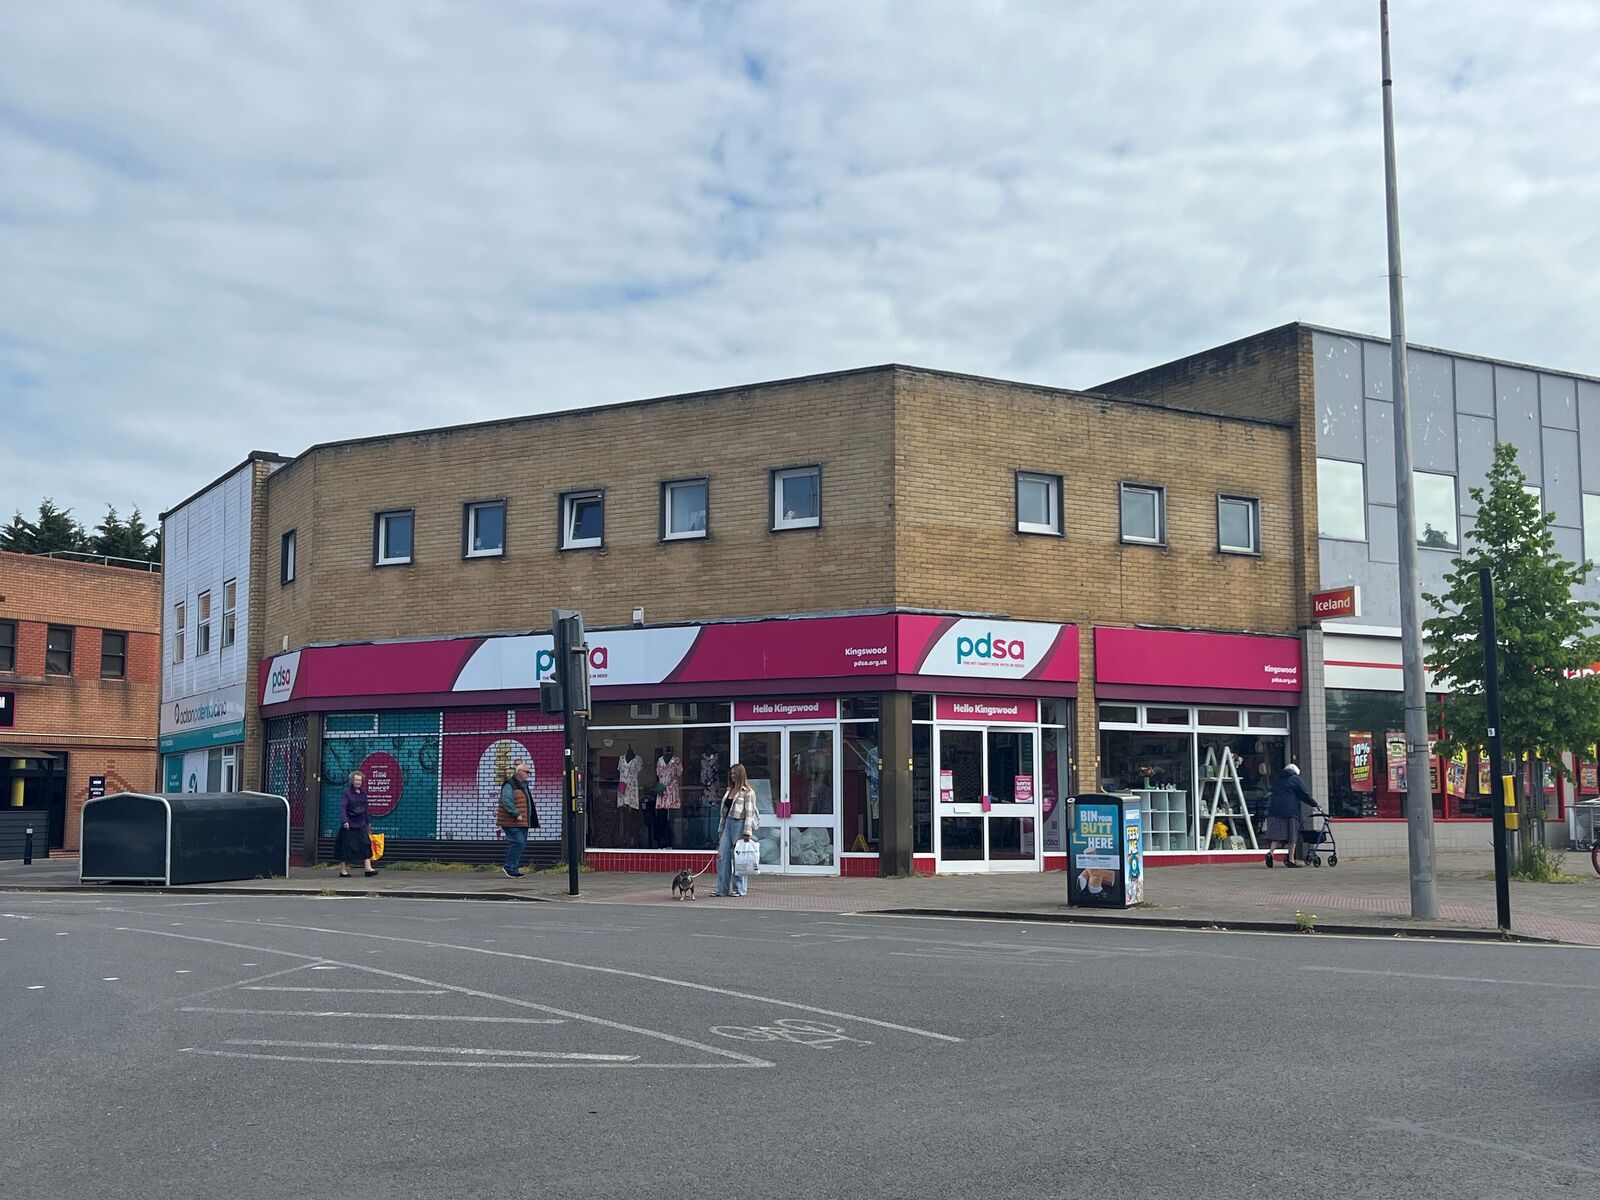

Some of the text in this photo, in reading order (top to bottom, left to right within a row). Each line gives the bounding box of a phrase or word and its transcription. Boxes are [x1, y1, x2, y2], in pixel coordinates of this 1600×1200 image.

[1315, 597, 1350, 612] Iceland
[845, 646, 887, 656] Kingswood
[957, 632, 1025, 664] pdsa
[536, 647, 608, 680] pa
[854, 659, 887, 667] pdsa.org.uk
[1264, 665, 1297, 674] Kingswood
[272, 665, 290, 694] pdsa
[753, 703, 819, 714] Hello Kingswood
[953, 704, 1018, 716] Hello Kingswood
[1353, 743, 1370, 755] 10%
[1355, 754, 1368, 766] OFF
[1080, 810, 1098, 822] BIN
[1081, 822, 1112, 834] BUTT
[1087, 837, 1114, 849] HERE
